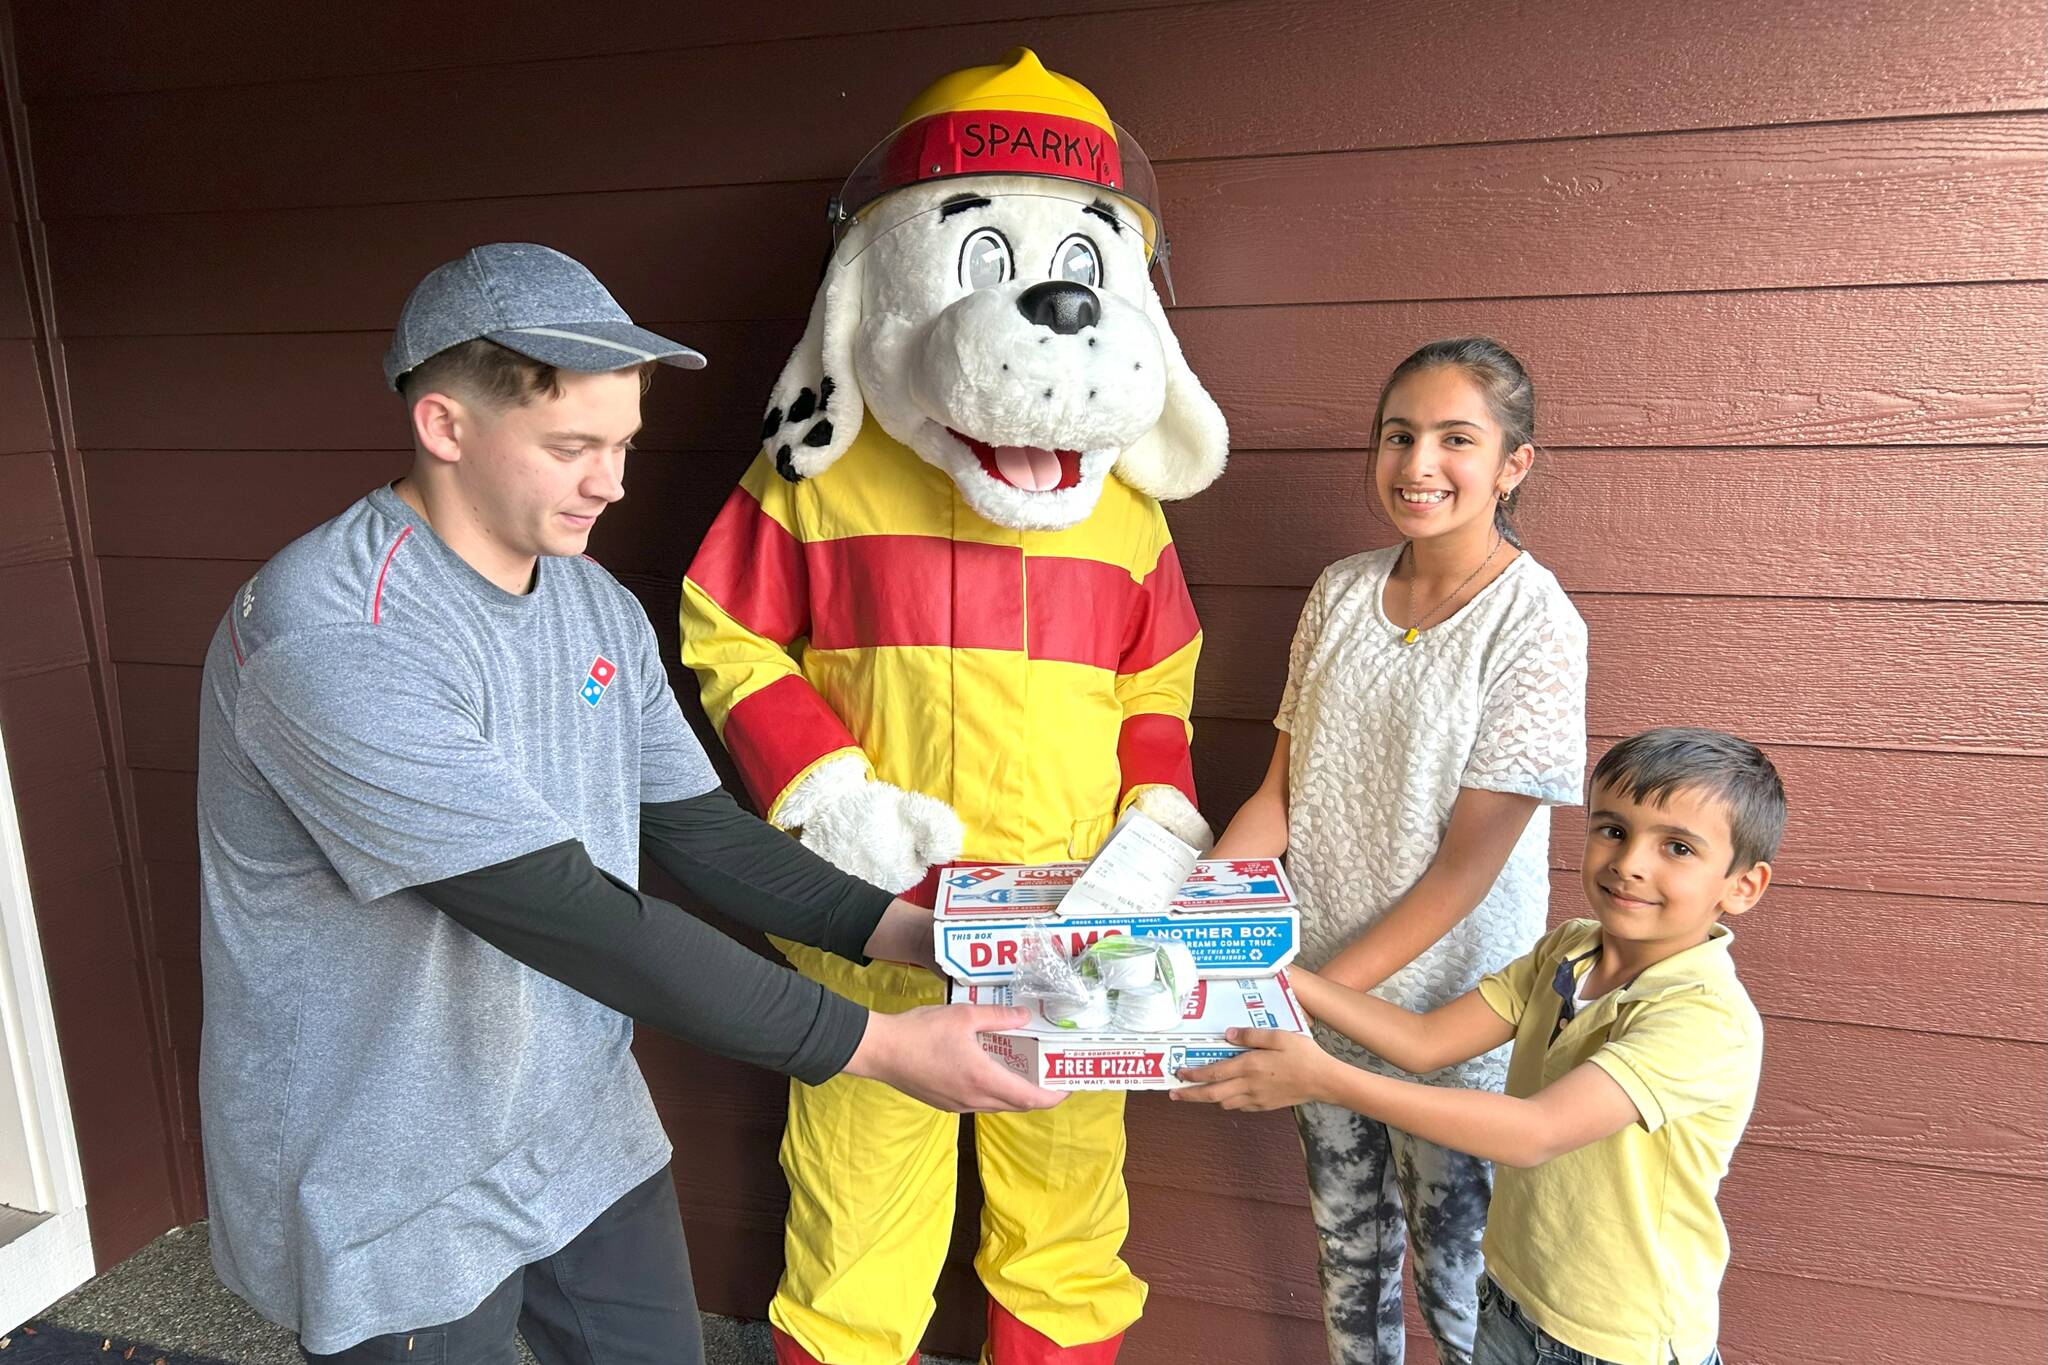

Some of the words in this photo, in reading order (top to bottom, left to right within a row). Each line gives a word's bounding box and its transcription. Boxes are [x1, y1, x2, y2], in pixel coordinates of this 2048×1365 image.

[961, 123, 1100, 170] SPARKY
[1146, 928, 1232, 938] ANOTHER
[1241, 927, 1282, 937] BOX.
[992, 1035, 1012, 1048] REAL
[983, 1043, 1012, 1056] CHEESE
[1055, 1060, 1094, 1075] FREE
[1101, 1059, 1155, 1075] PIZZA?
